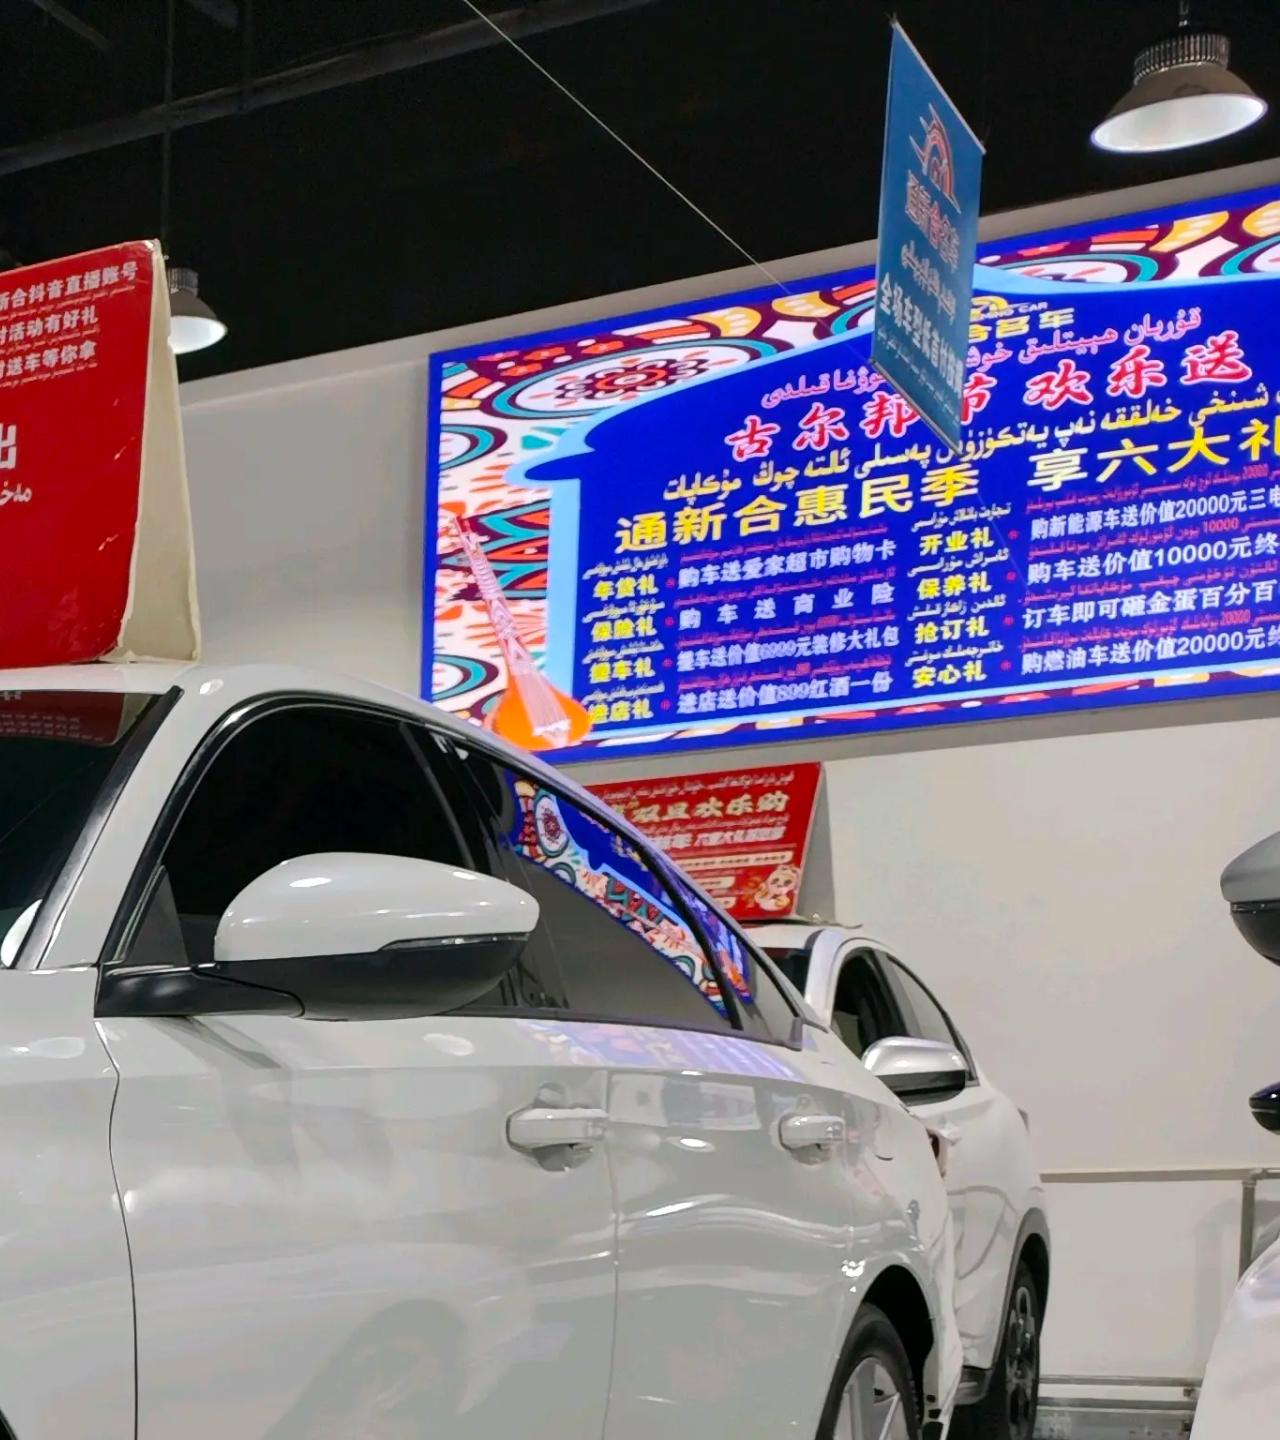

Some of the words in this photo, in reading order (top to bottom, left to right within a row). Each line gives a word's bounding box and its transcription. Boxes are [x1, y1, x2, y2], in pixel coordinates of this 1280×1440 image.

[615, 463, 979, 554] 通新合惠民季
[919, 527, 994, 556] 开业礼
[1023, 578, 1280, 629] 订车即可砸金蛋百分百
